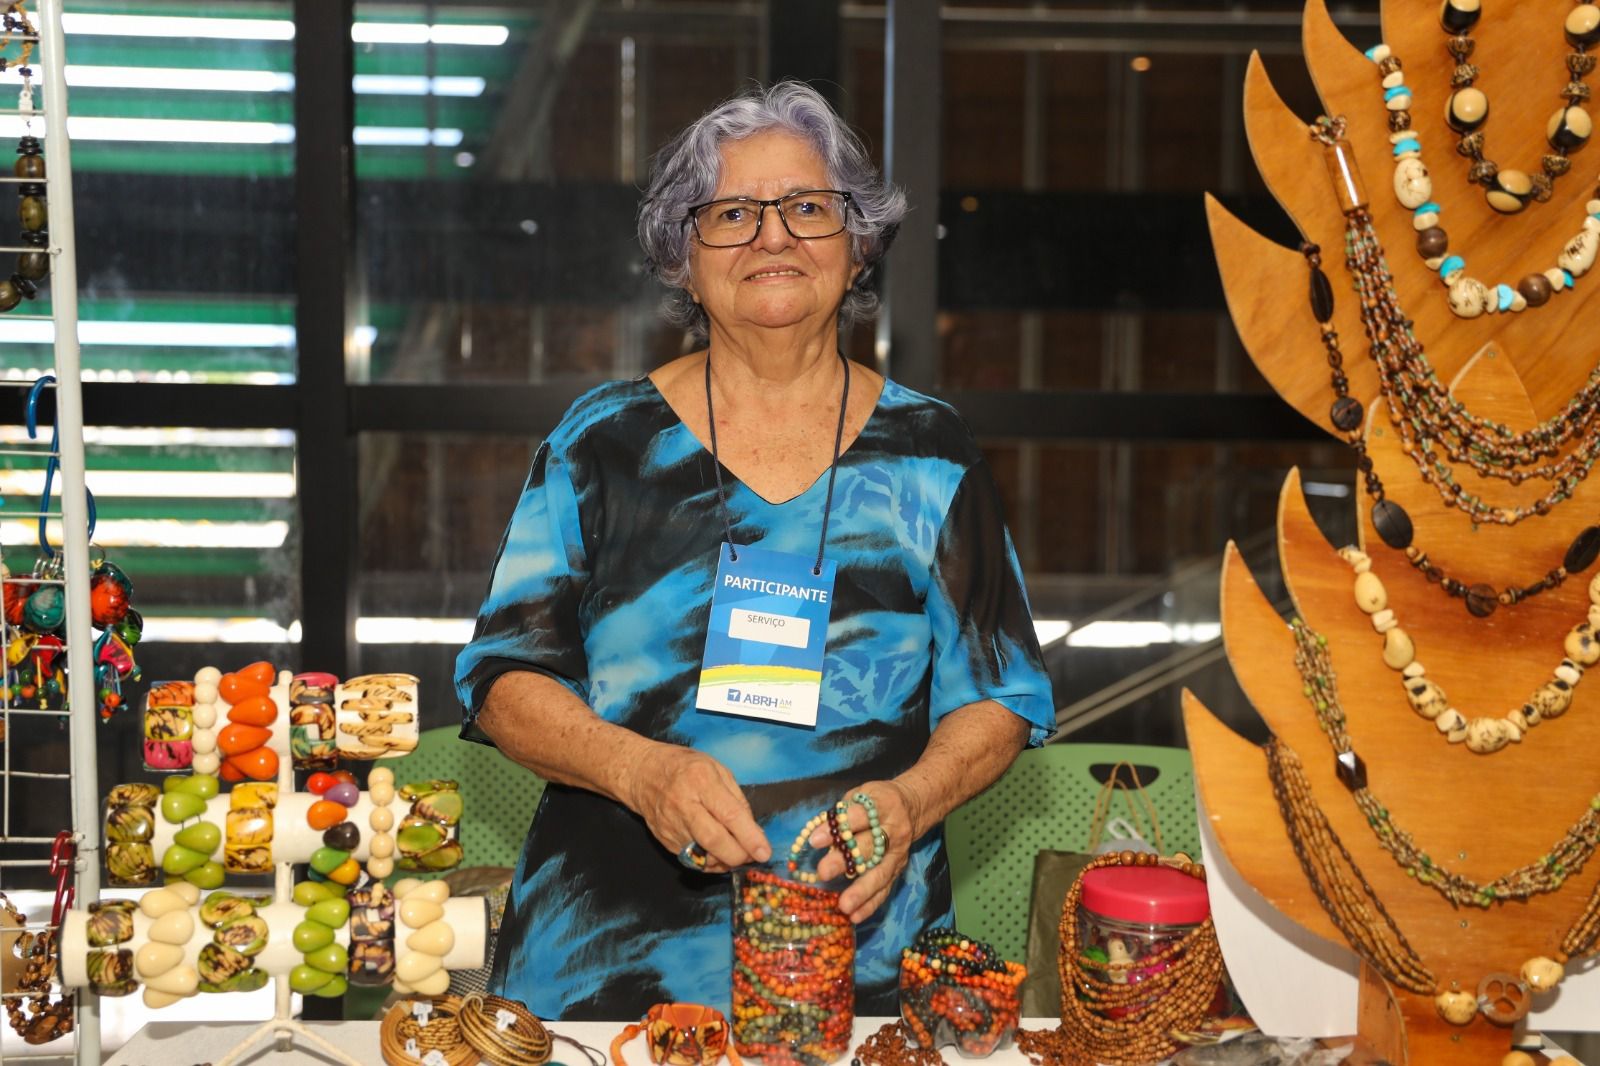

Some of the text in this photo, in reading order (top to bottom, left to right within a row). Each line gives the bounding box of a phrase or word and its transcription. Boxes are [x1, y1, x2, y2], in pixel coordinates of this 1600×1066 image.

[724, 574, 828, 603] PARTICIPANTE
[747, 614, 785, 628] SERVIÇO
[743, 693, 778, 707] ABRH
